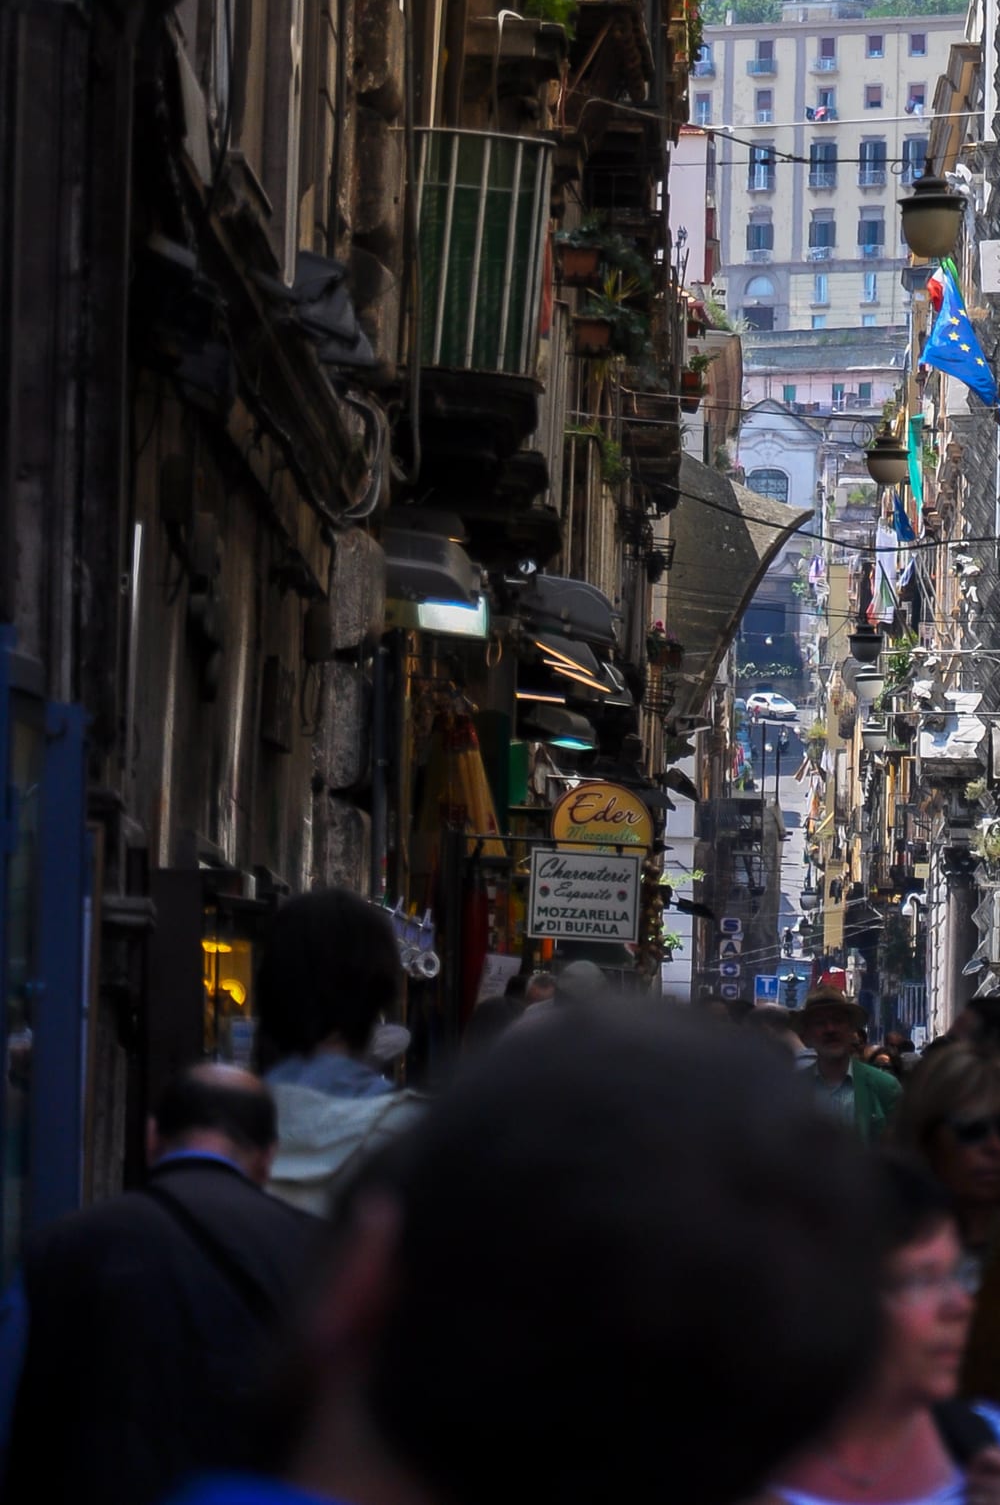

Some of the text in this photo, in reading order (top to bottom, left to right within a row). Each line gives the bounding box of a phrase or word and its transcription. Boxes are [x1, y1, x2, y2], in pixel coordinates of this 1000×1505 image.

[568, 792, 641, 825] Eder
[538, 857, 632, 884] Charcuterie
[554, 881, 612, 902] Esposito
[537, 906, 630, 922] MOZZARELLA
[547, 921, 619, 935] DI BUFALA
